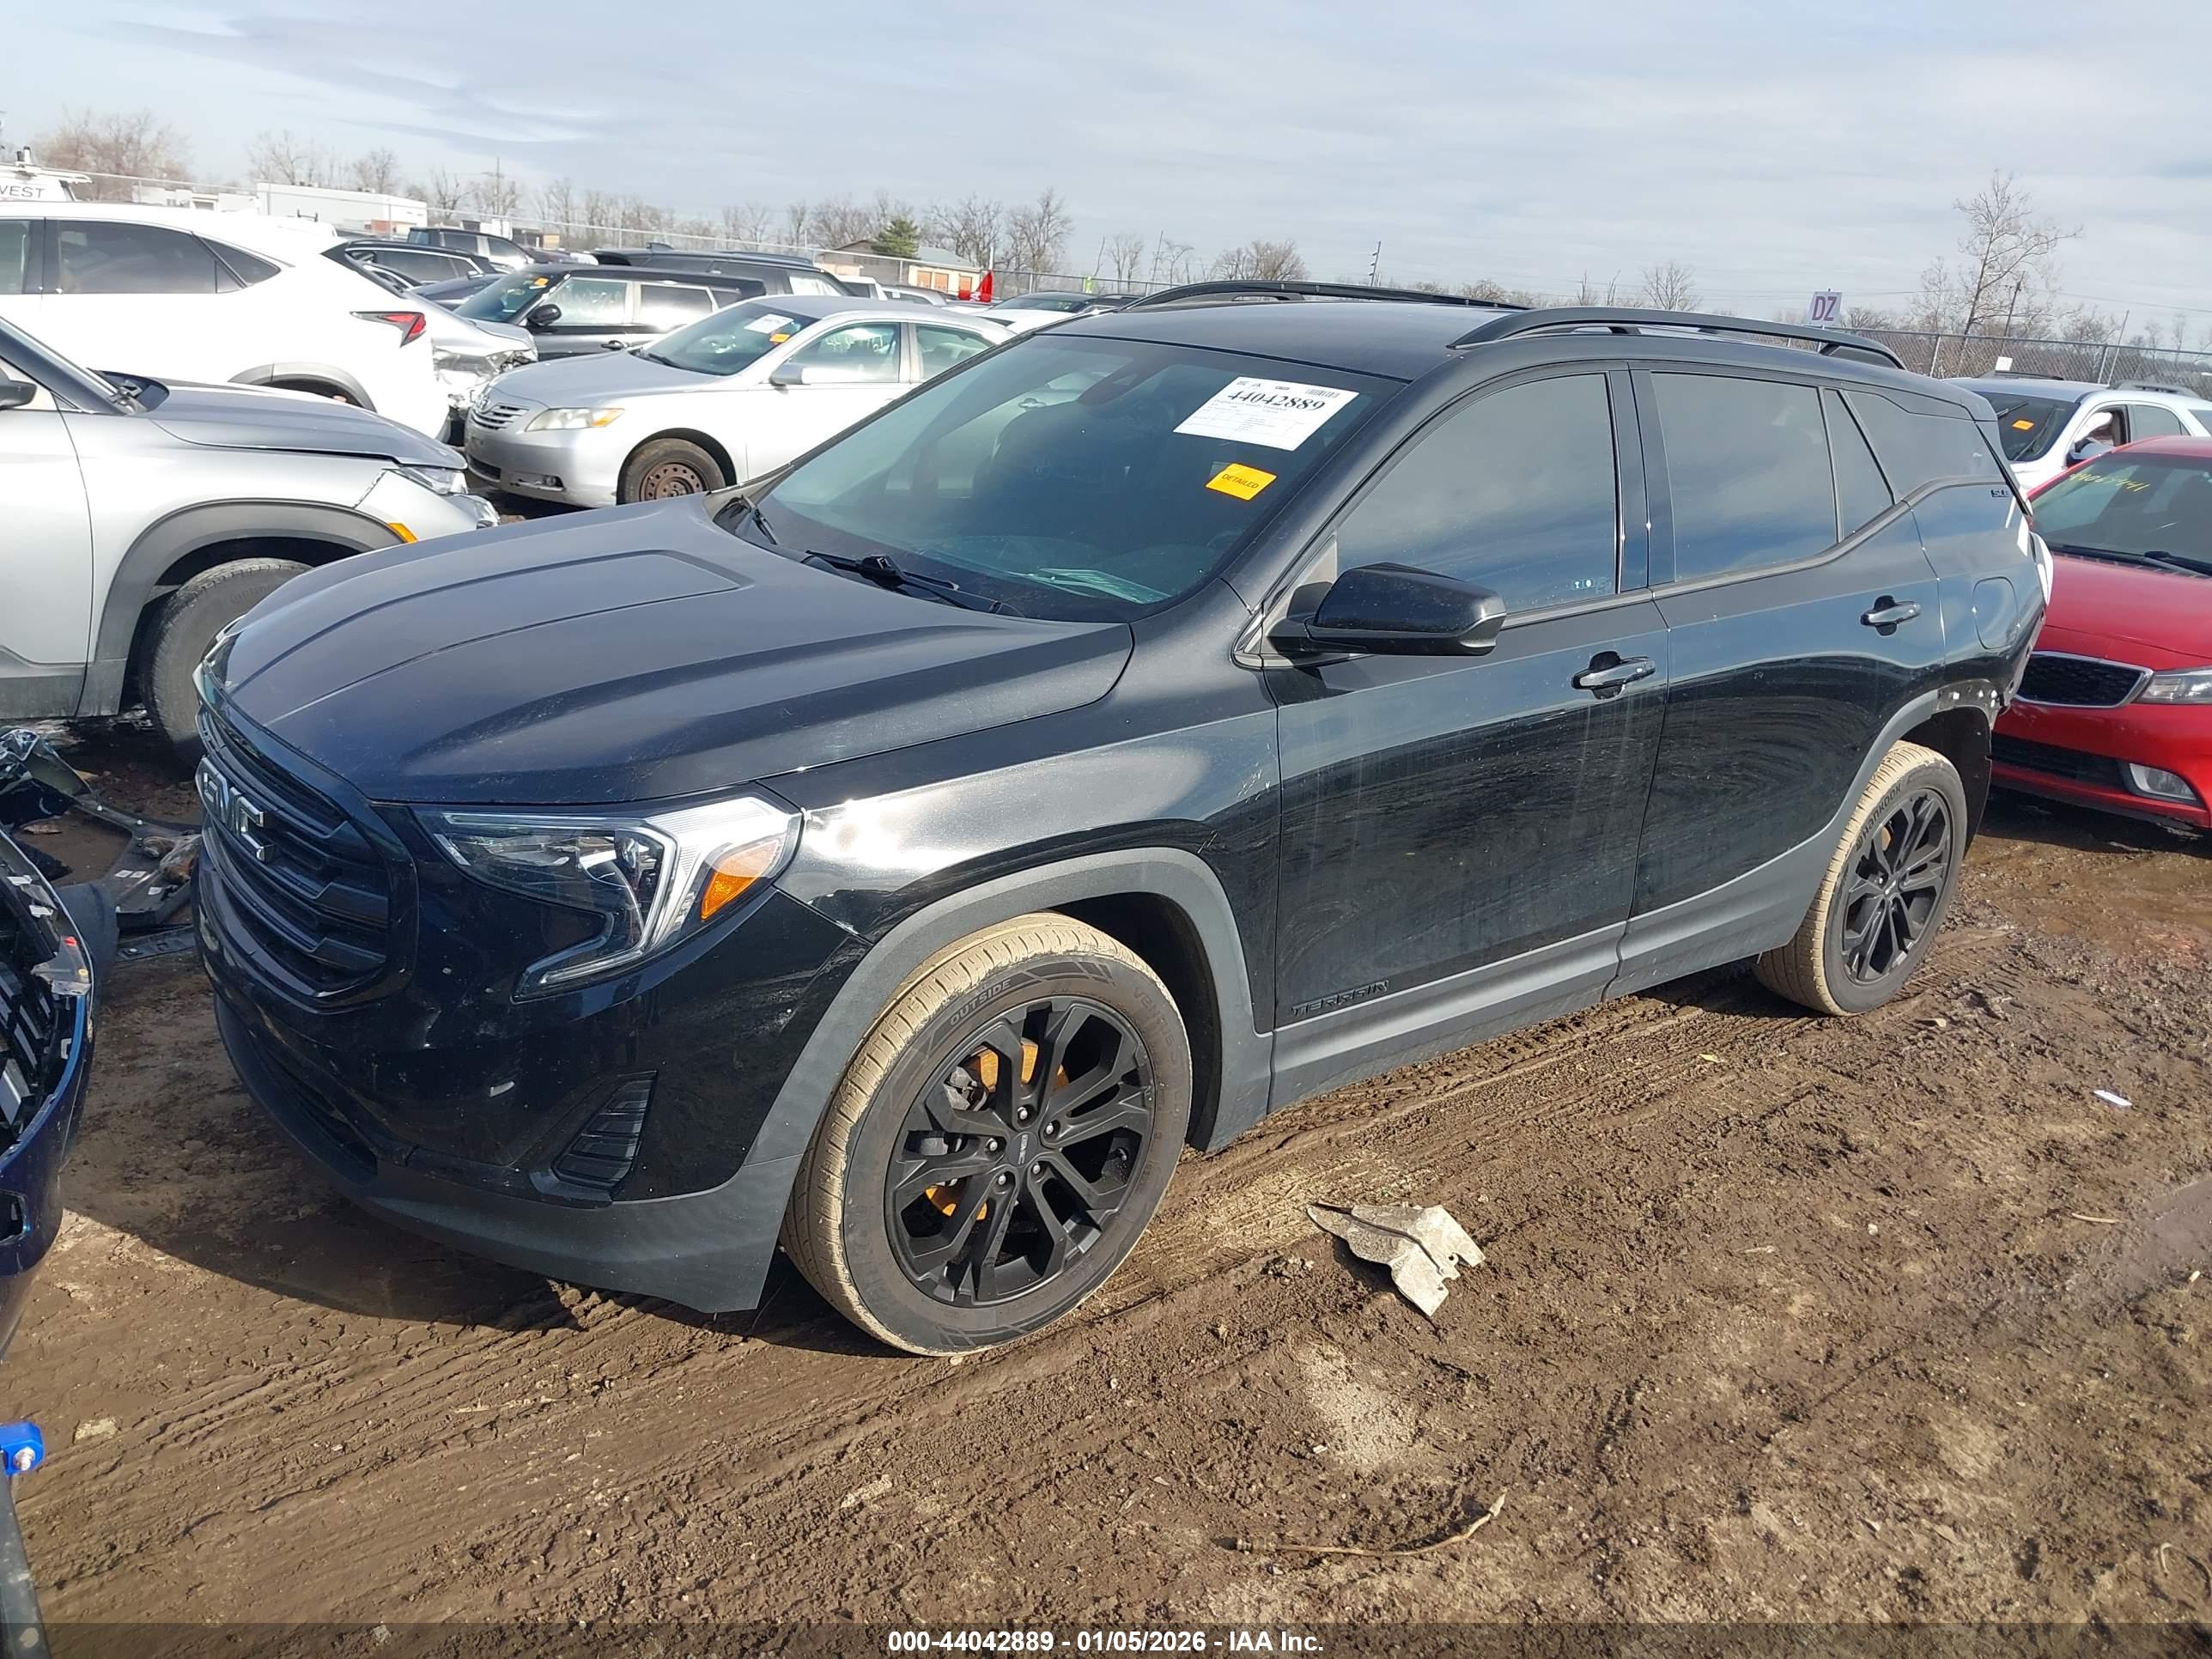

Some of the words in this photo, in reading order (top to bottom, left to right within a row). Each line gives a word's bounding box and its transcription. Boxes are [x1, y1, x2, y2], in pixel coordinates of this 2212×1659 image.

[1812, 295, 1838, 322] DZ
[1228, 390, 1326, 411] 44042889
[1222, 473, 1260, 489] DETAILED
[195, 756, 267, 862] GMC
[950, 979, 1012, 1026] OUTSIDE
[1291, 979, 1389, 1017] TERRAIN
